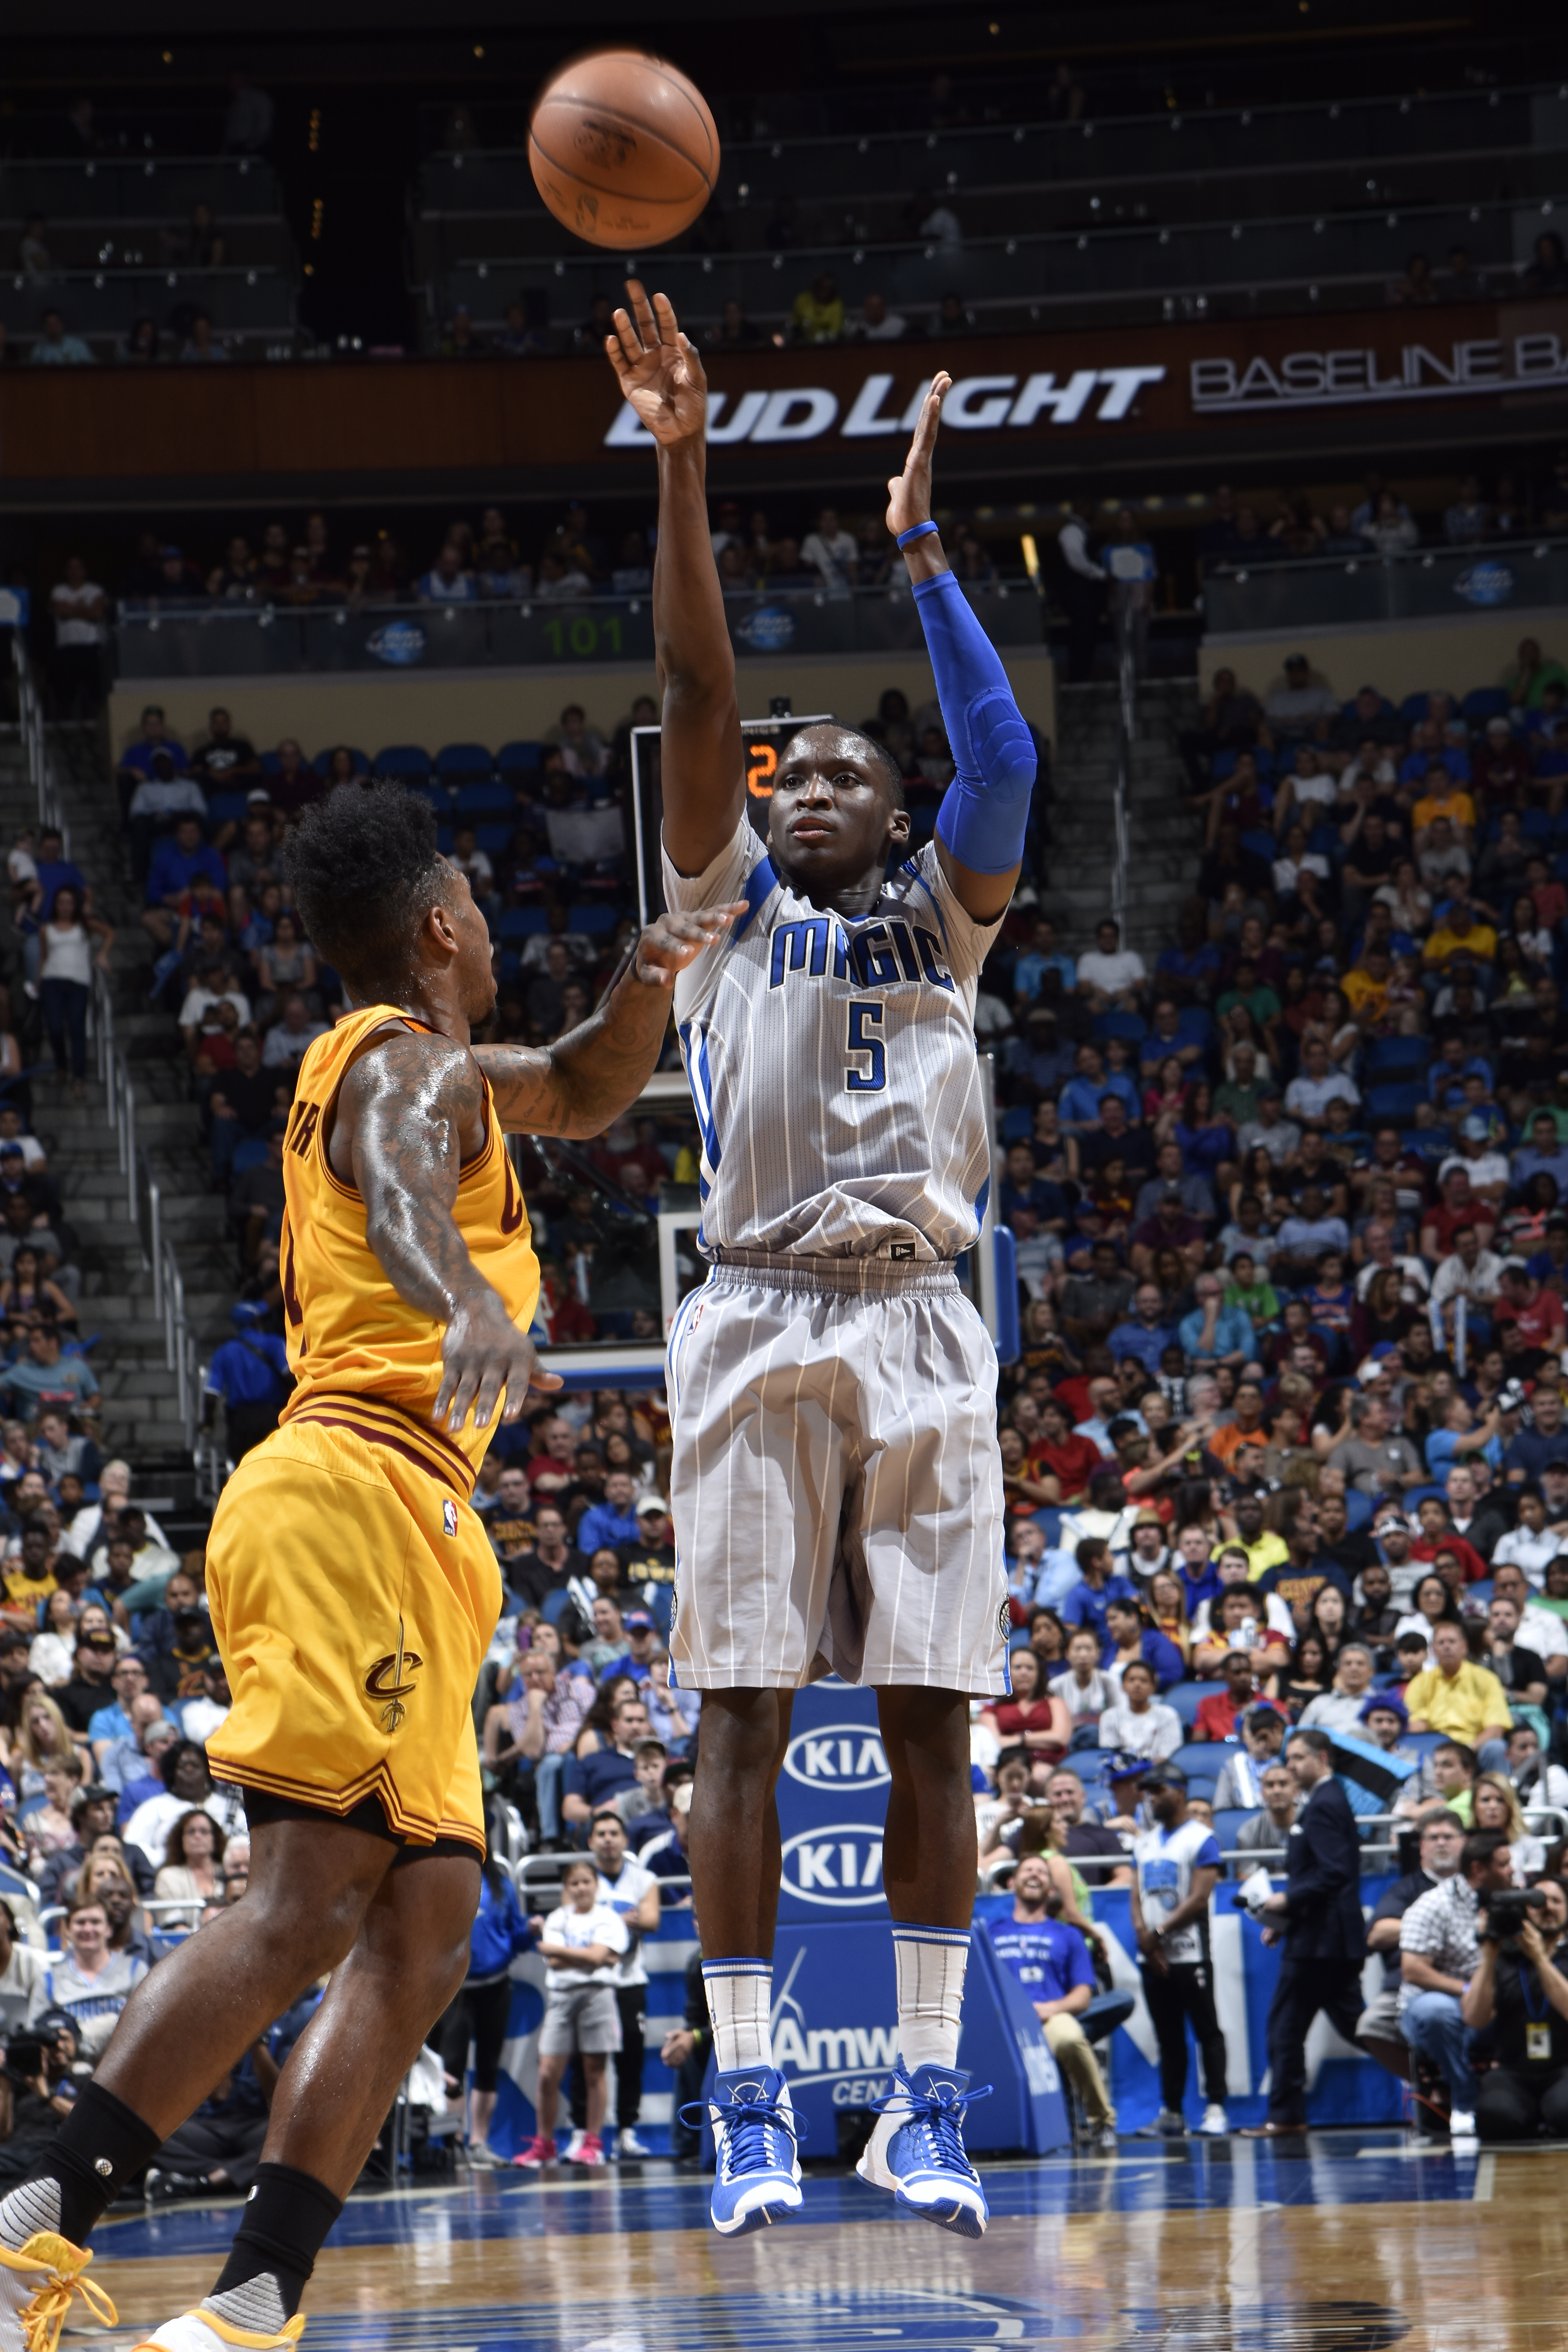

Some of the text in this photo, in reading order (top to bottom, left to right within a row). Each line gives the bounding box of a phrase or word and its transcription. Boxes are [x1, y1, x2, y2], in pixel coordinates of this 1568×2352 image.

[1191, 332, 1568, 402] BASELINE B
[542, 616, 622, 655] 101
[768, 918, 956, 994] MAGIC
[844, 998, 887, 1094] 5
[804, 1739, 888, 1777] KIA
